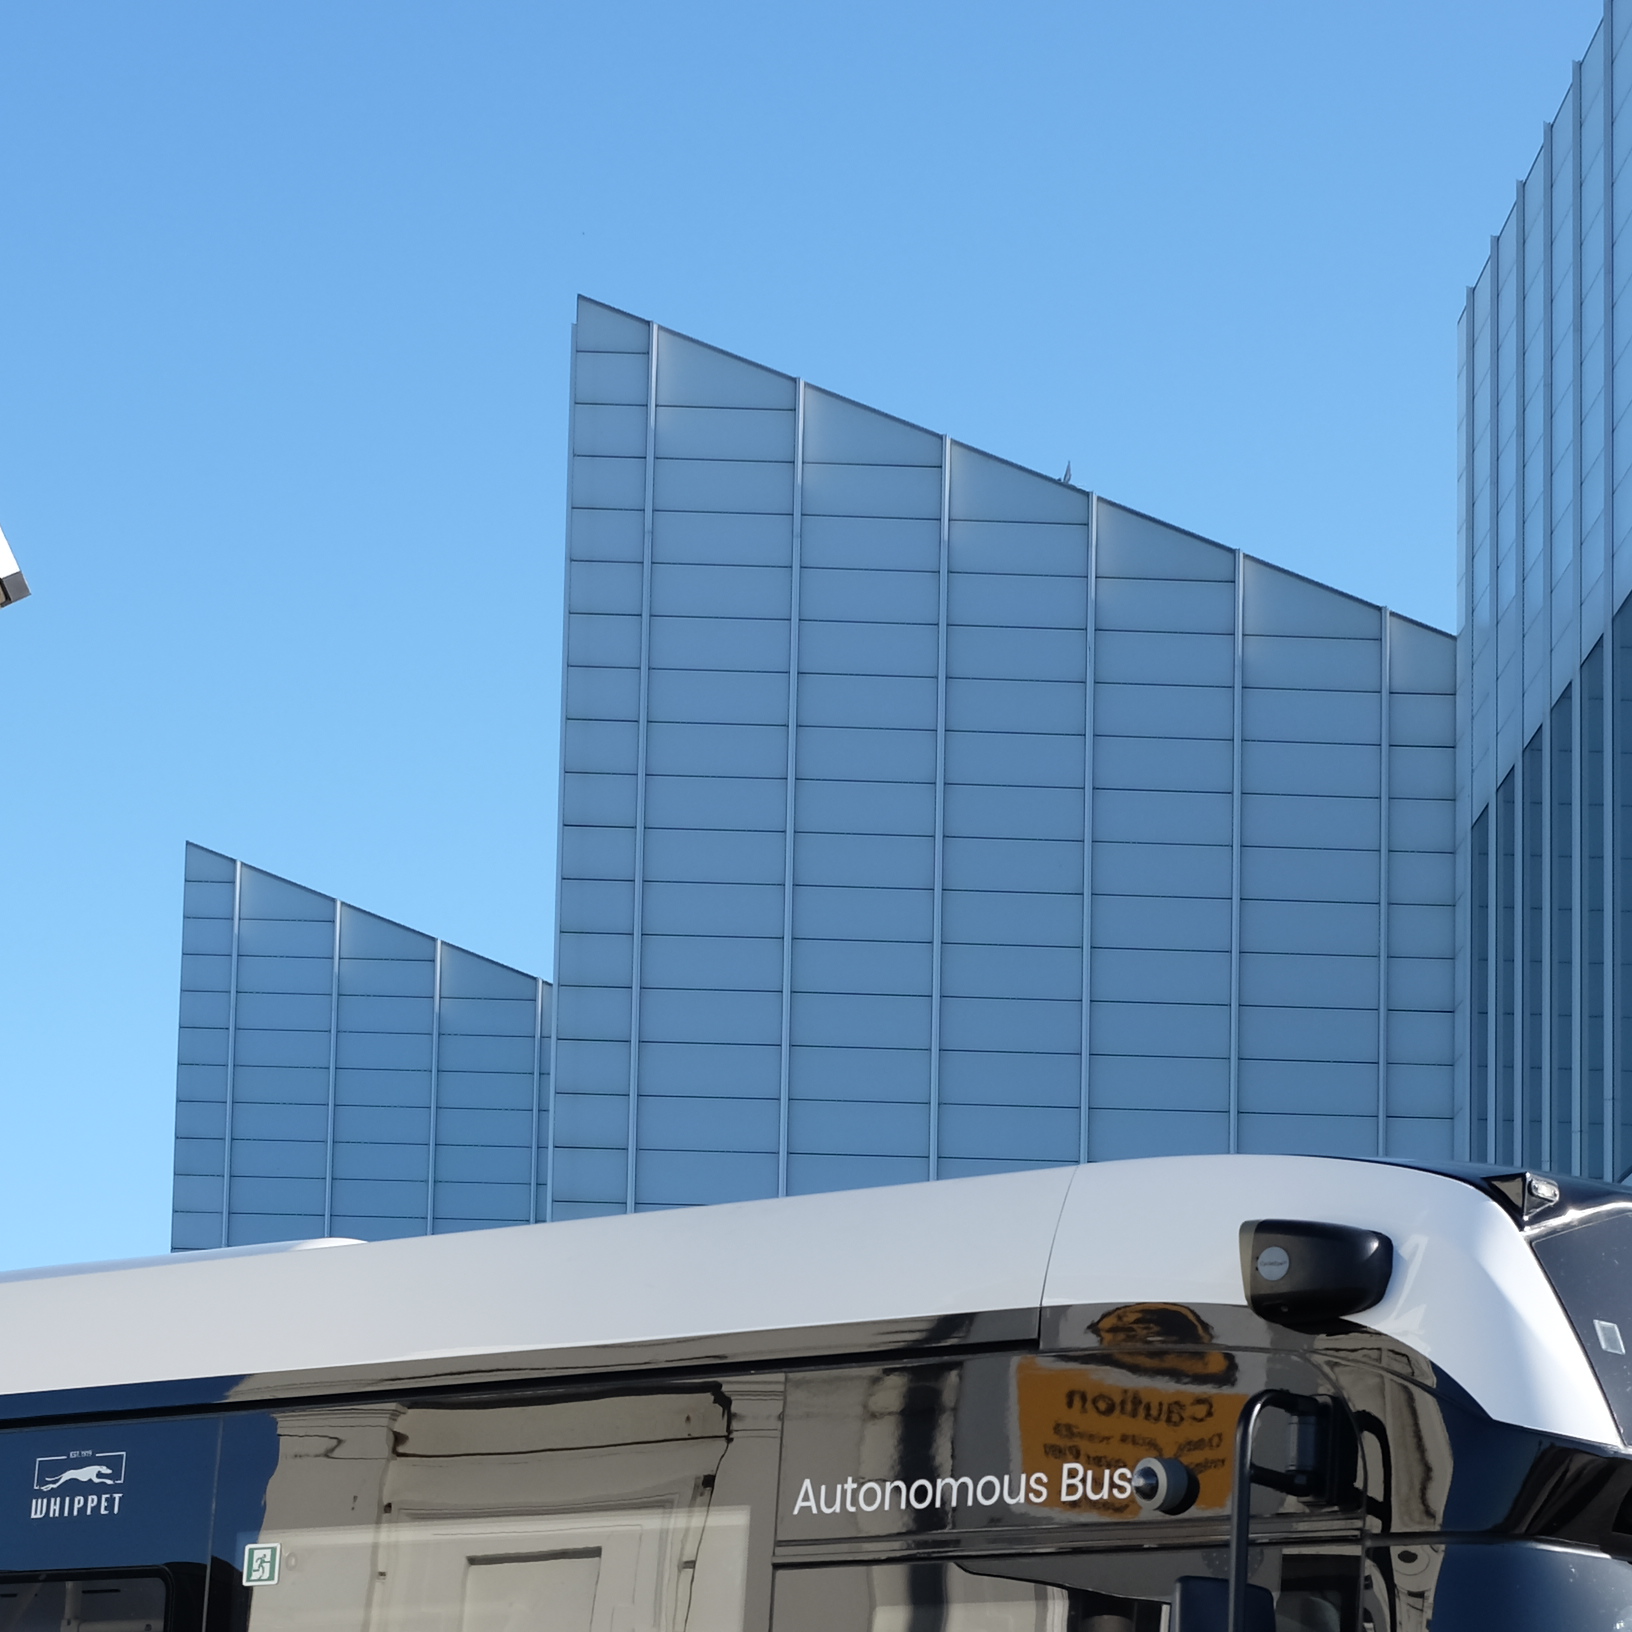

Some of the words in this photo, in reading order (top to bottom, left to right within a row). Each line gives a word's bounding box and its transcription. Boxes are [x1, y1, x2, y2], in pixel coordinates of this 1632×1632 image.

[31, 1493, 124, 1519] WHIPPET
[793, 1470, 1049, 1516] Autonomous
[1059, 1462, 1133, 1503] Bus
